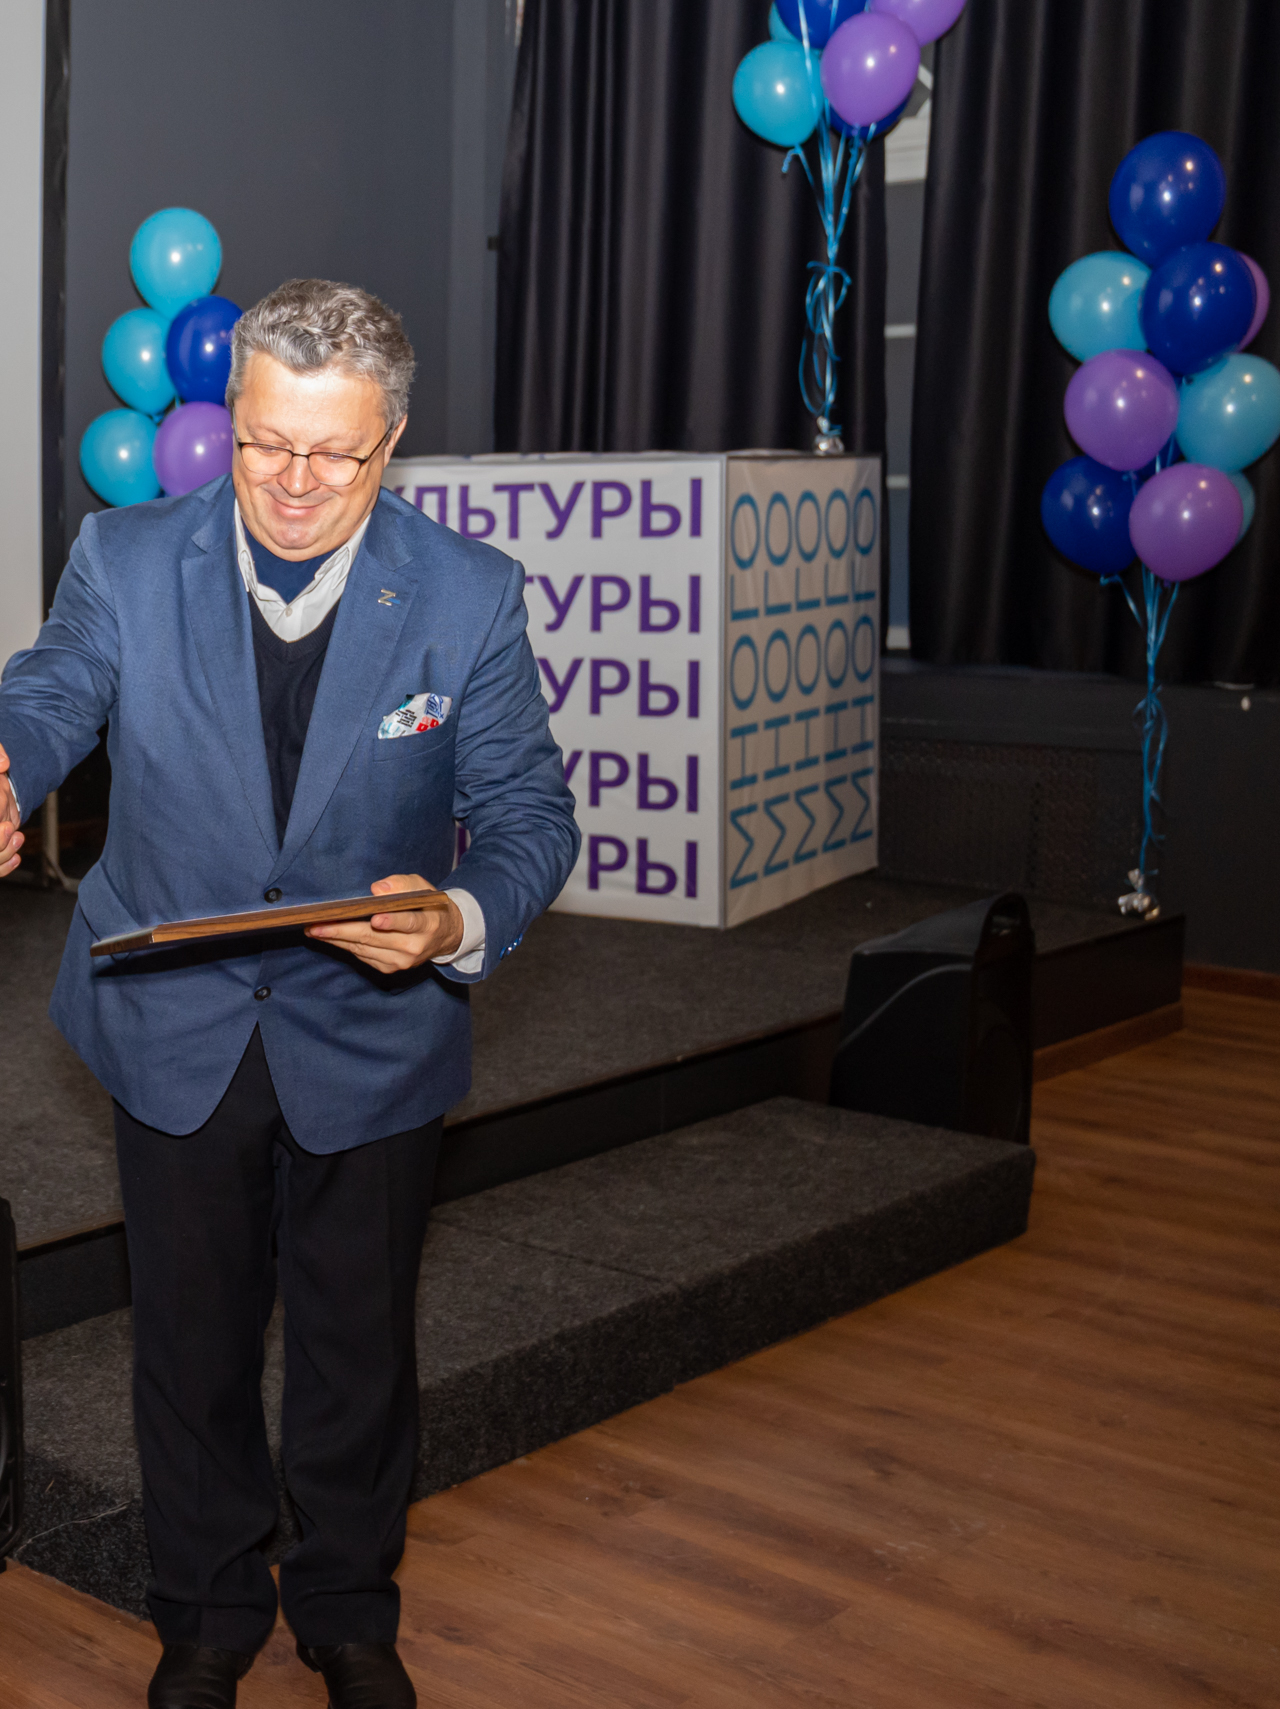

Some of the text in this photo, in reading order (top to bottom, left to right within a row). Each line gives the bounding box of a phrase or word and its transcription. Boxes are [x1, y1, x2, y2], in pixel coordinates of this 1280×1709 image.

[391, 477, 703, 540] ЛЬТУРЫ
[525, 574, 702, 634] УРЫ
[763, 491, 793, 877] МНОГО
[793, 489, 822, 865] МНОГО
[822, 488, 851, 853] МНОГО
[850, 487, 878, 844] МНОГО
[581, 833, 698, 899] РЫ
[730, 493, 761, 889] МНОГО
